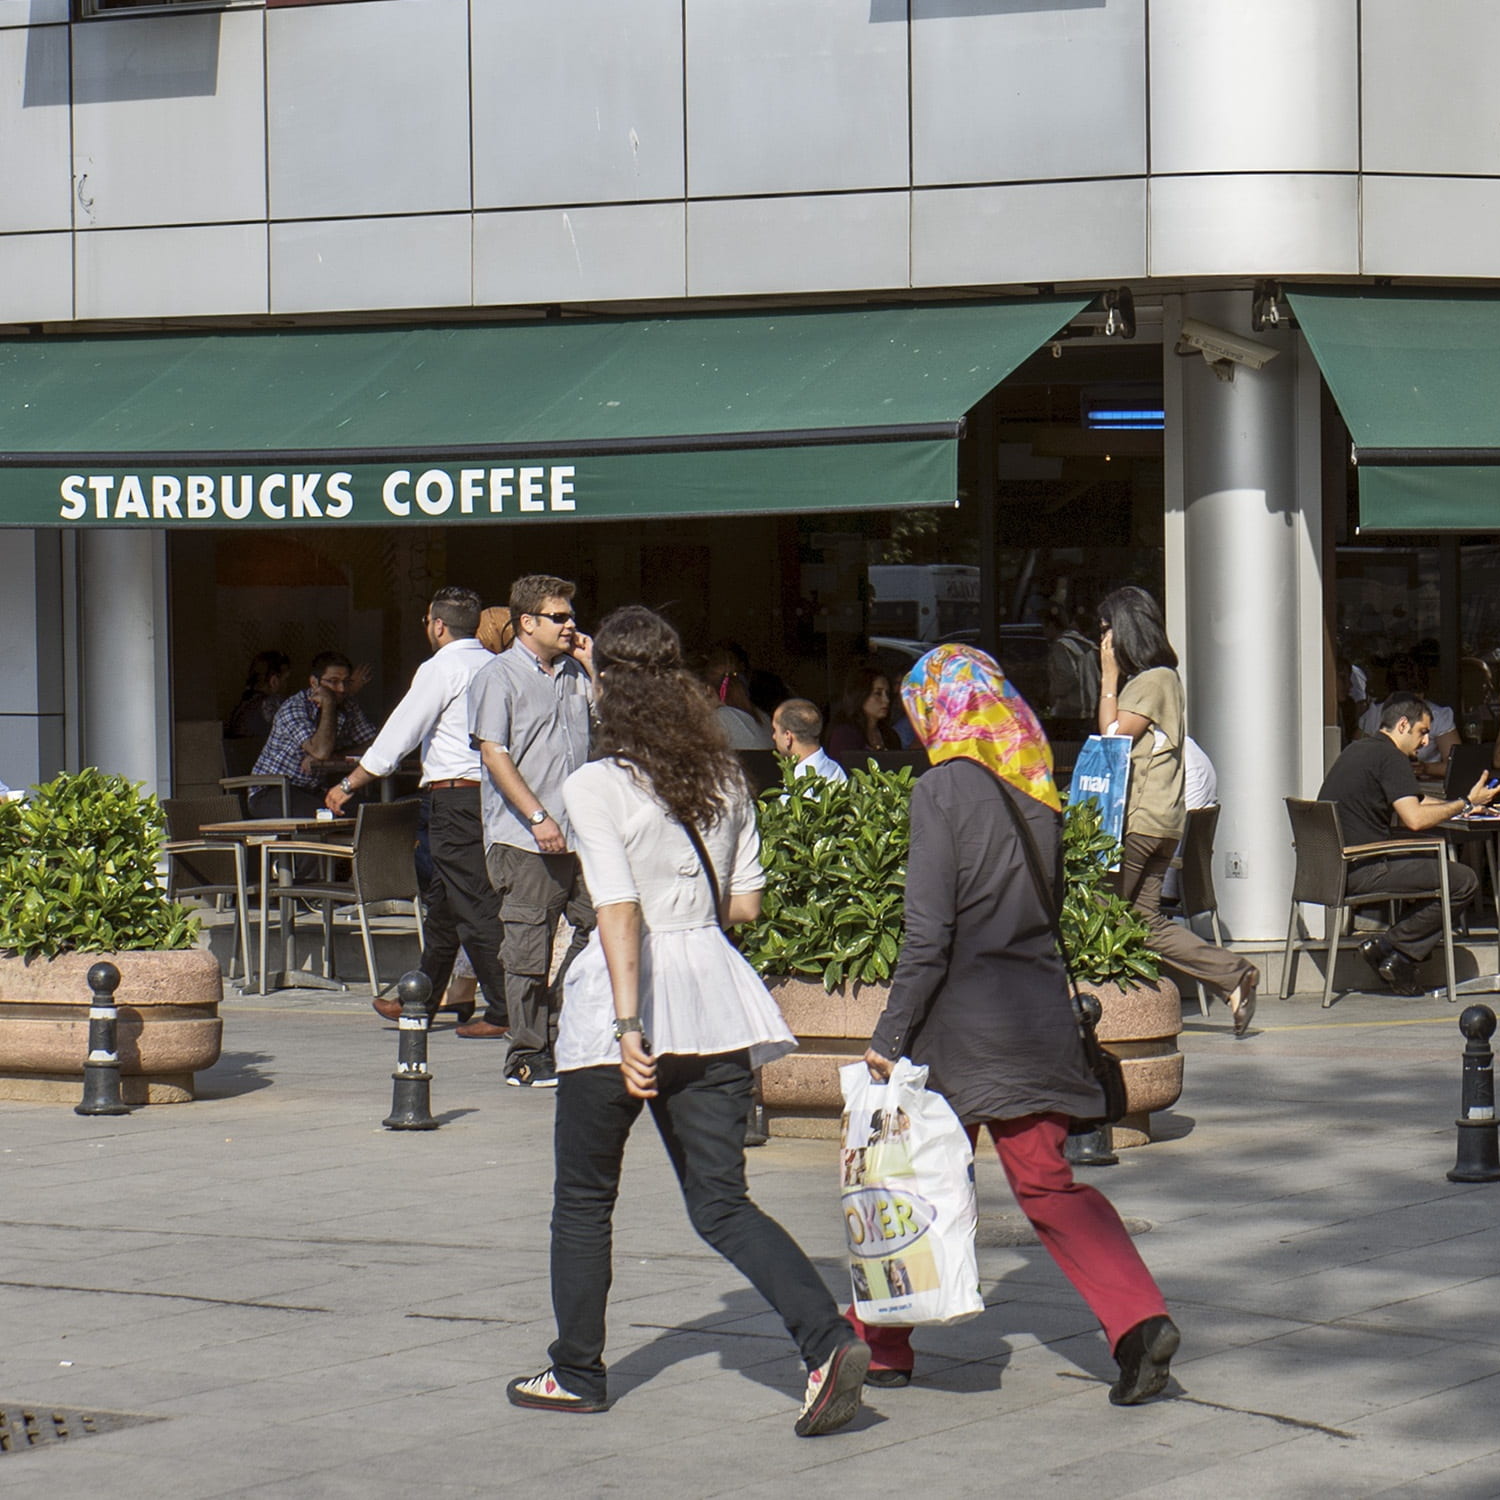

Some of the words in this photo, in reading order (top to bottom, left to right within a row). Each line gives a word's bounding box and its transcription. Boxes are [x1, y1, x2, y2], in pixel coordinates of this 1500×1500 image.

[58, 472, 354, 521] STARBUCKS
[382, 465, 577, 517] COFFEE
[1079, 773, 1112, 794] mavi
